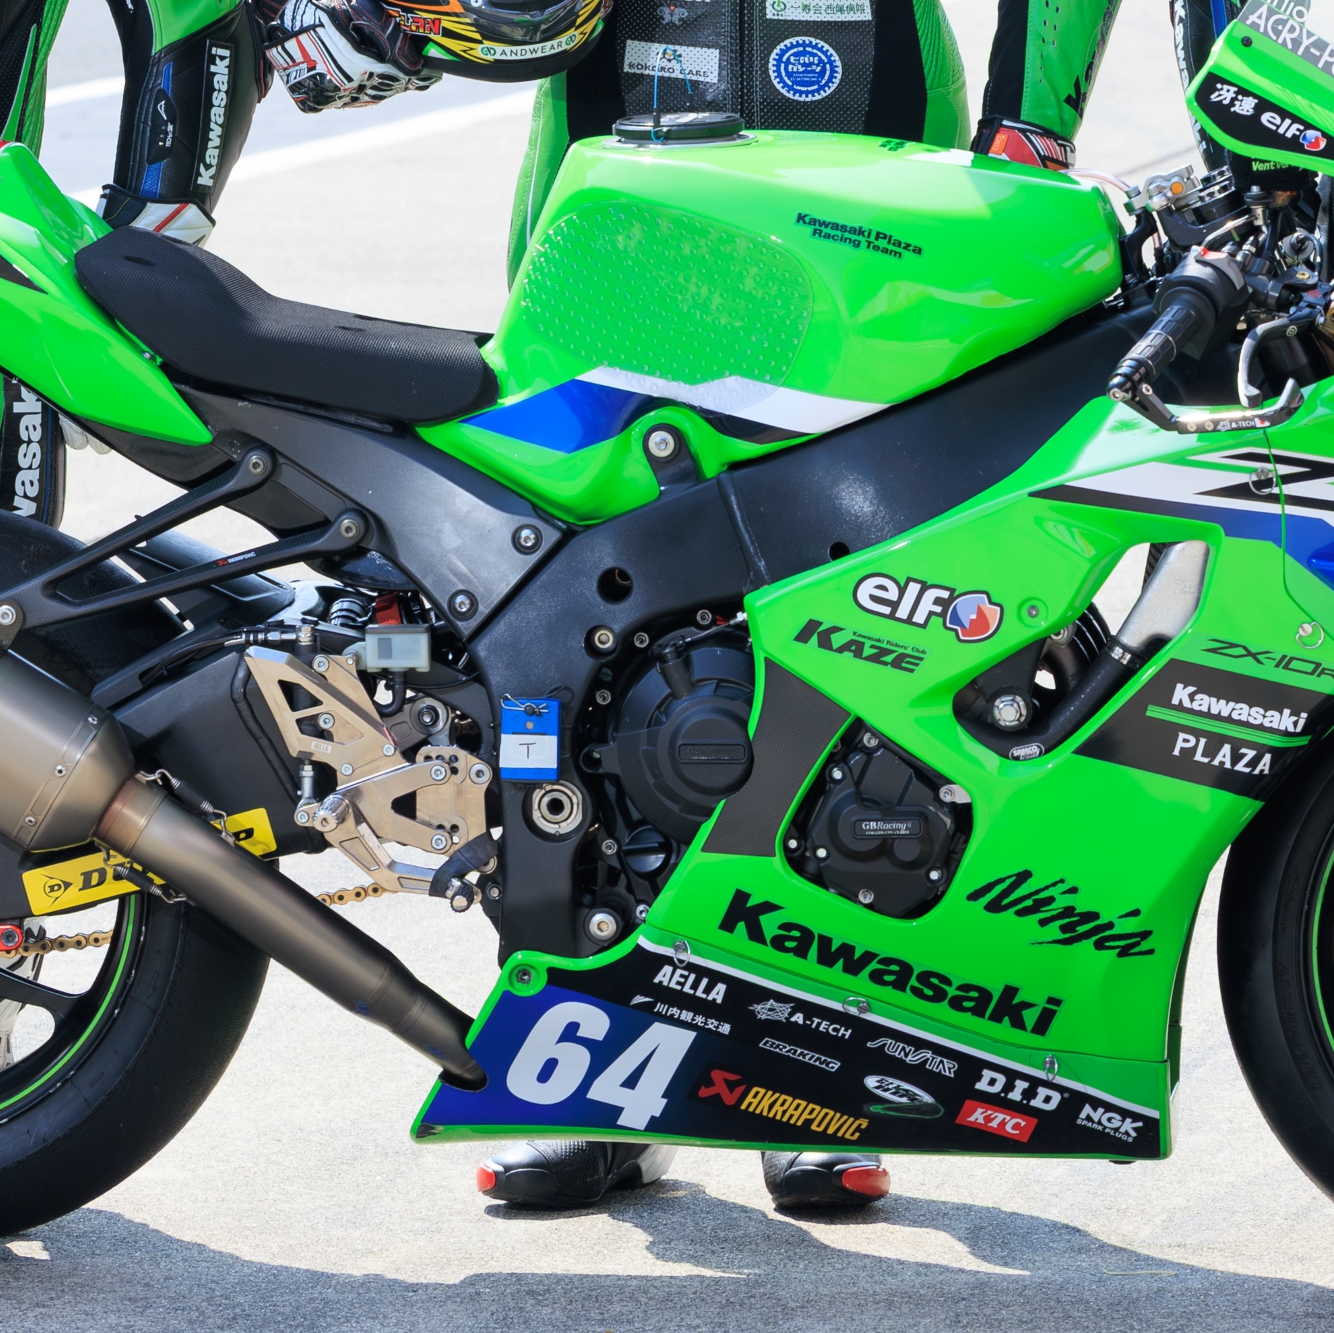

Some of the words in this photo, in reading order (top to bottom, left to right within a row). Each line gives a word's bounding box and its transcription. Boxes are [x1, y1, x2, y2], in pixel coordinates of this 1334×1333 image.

[499, 41, 563, 57] ANDWEAR
[628, 61, 675, 75] KOKORO
[679, 65, 709, 79] CARE
[196, 46, 231, 188] Kawasaki
[1260, 111, 1305, 139] elf
[796, 212, 872, 239] Kawasaki
[874, 230, 923, 256] Plaza
[812, 227, 862, 249] Racing
[865, 239, 902, 259] Team
[1231, 420, 1255, 428] A-TECH
[855, 576, 951, 625] elf
[792, 618, 925, 674] KAZE
[852, 630, 885, 645] Kawasaki
[911, 646, 927, 655] Club
[1171, 683, 1308, 734] Kawasaki
[1172, 732, 1273, 775] PLAZA
[862, 820, 908, 832] GBRacing
[966, 869, 1155, 958] Ninja
[717, 887, 1066, 1038] Kawasaki
[654, 964, 727, 1004] AELLA
[789, 1012, 853, 1040] A-TECH
[506, 1001, 698, 1131] 64
[759, 1037, 841, 1072] BRAKING
[867, 1037, 958, 1078] SUNSTAR
[974, 1068, 1062, 1111] D.I.D
[967, 1107, 1027, 1135] KTC
[1075, 1118, 1105, 1132] SPARK
[1104, 1128, 1134, 1142] PLUGS
[1078, 1103, 1143, 1138] NGK
